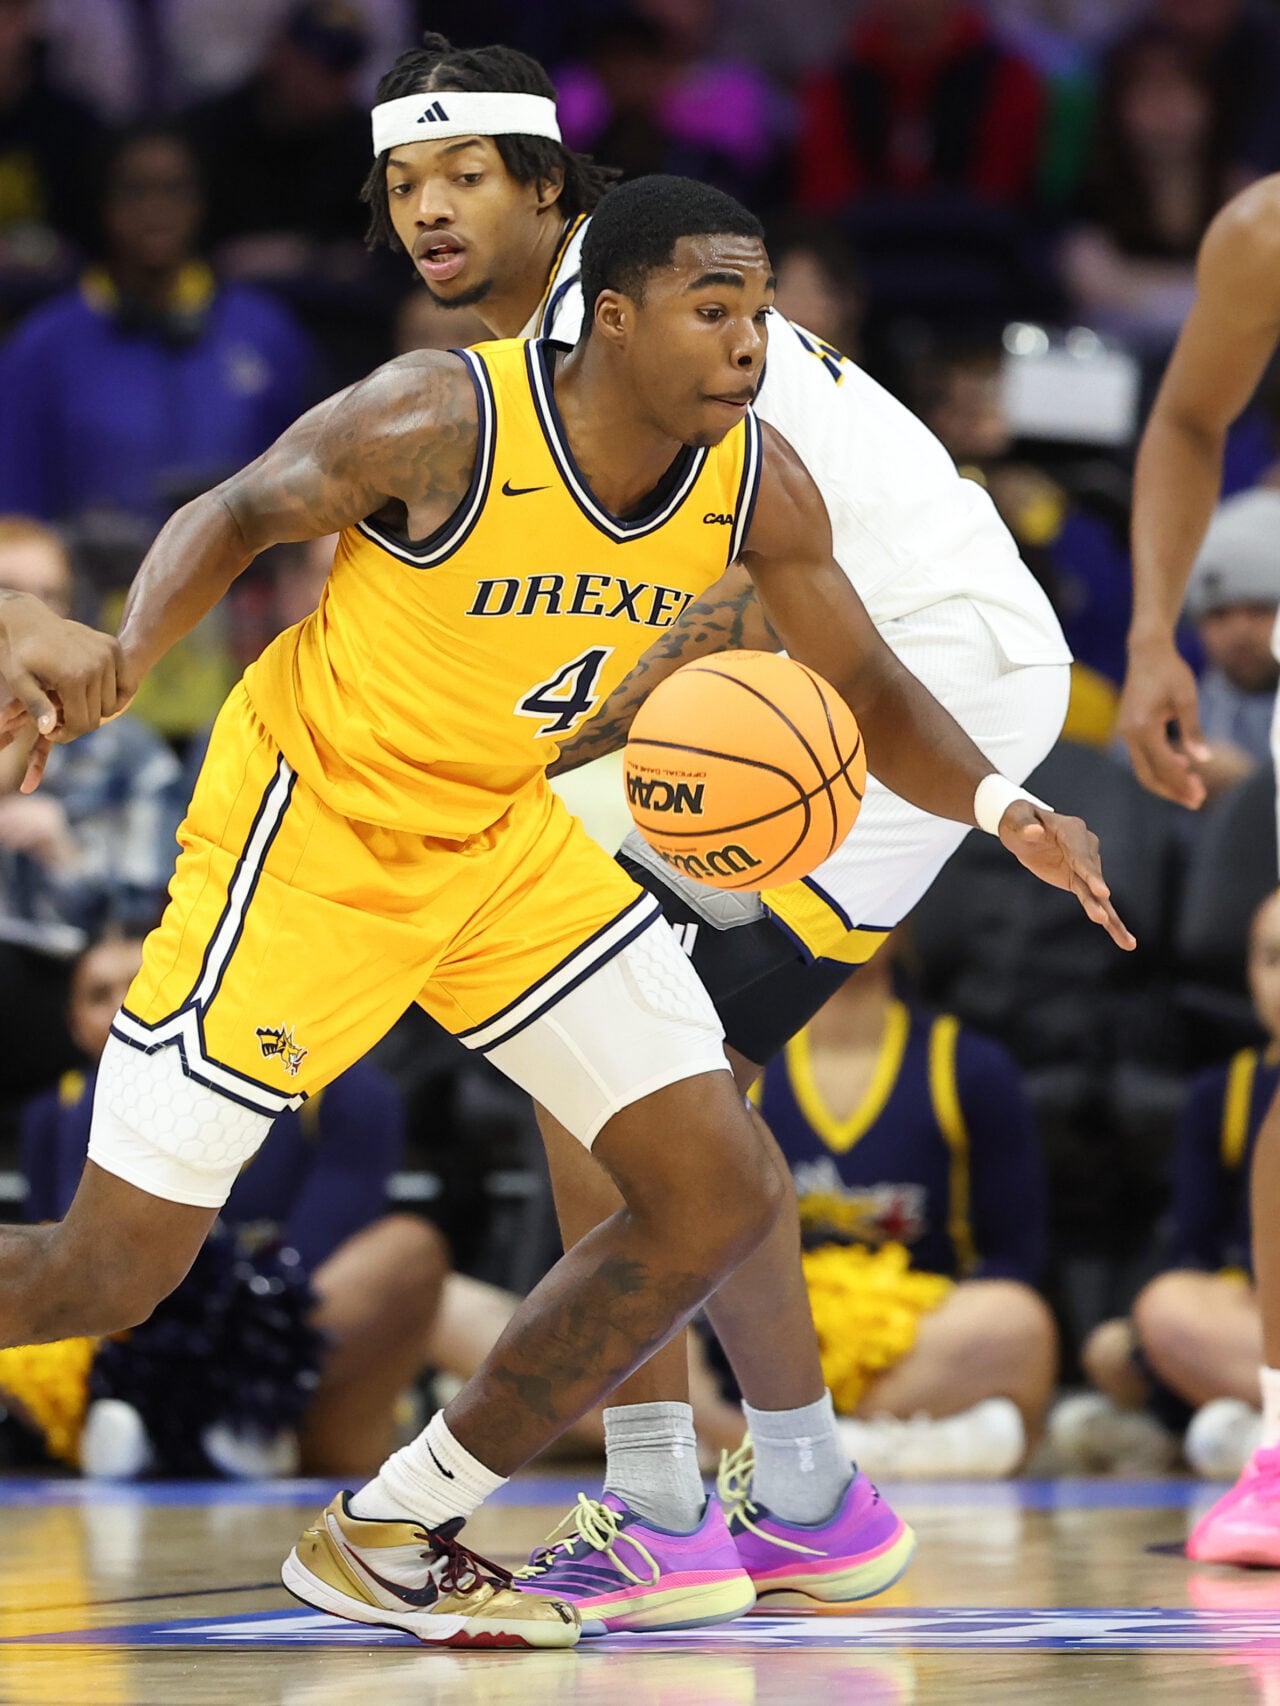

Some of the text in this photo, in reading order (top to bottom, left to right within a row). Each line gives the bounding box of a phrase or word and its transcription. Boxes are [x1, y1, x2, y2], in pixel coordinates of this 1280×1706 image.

[702, 512, 734, 526] CAA
[513, 645, 616, 740] 4
[626, 769, 706, 815] NCAA
